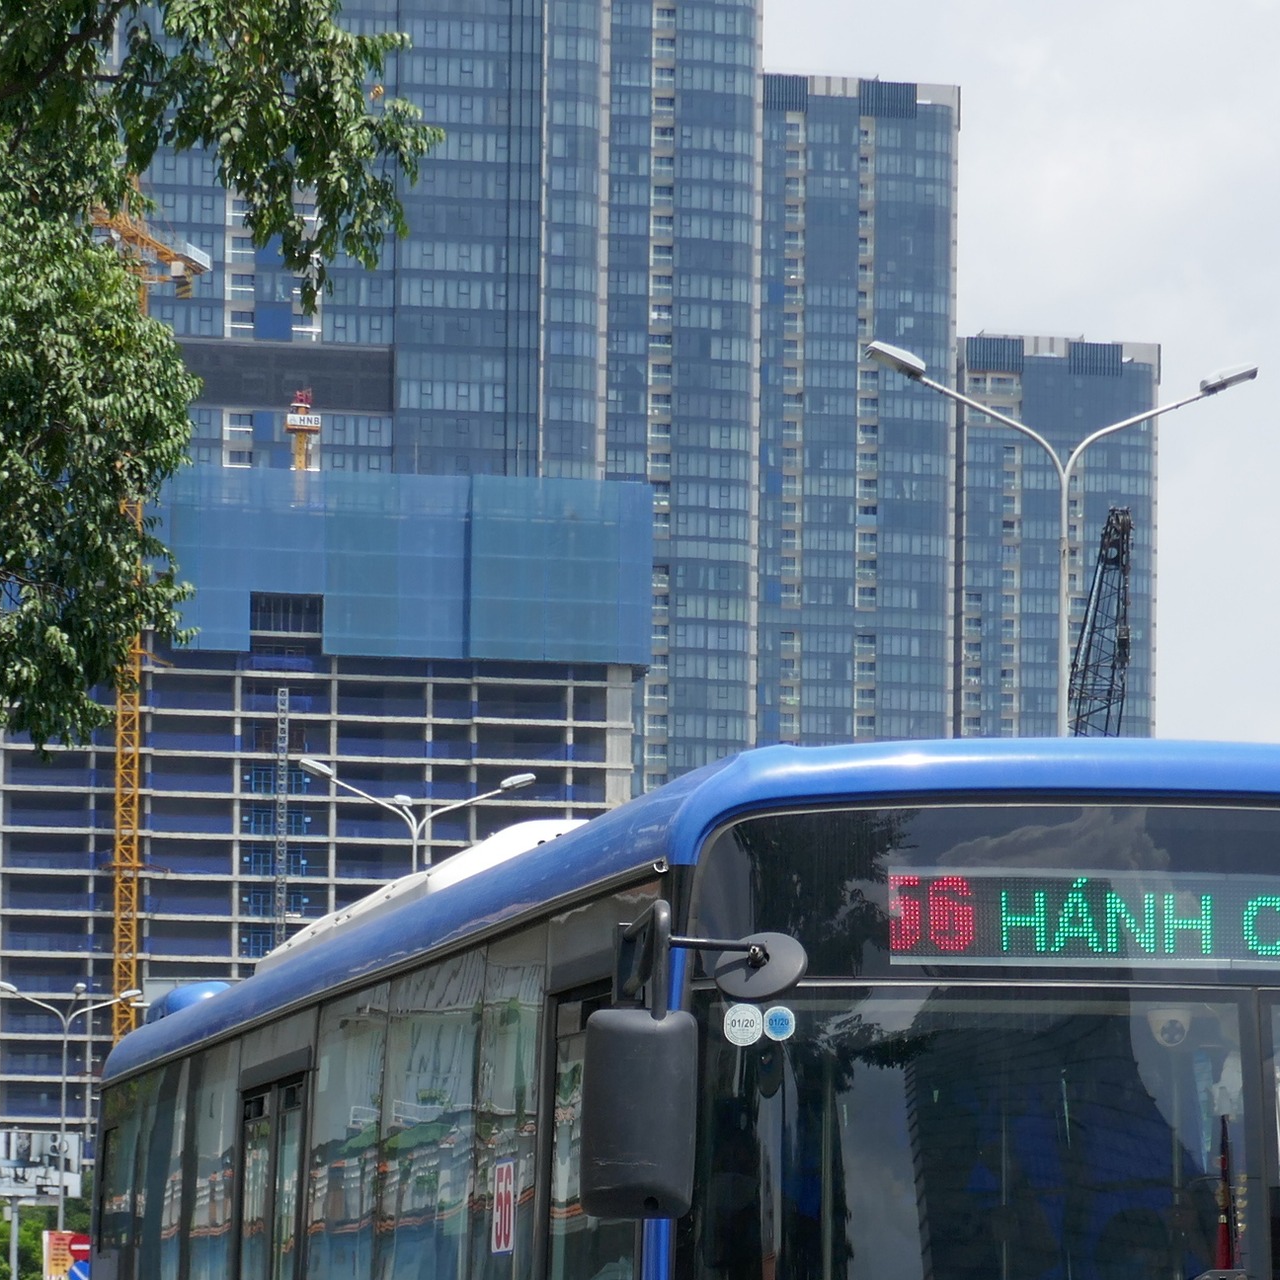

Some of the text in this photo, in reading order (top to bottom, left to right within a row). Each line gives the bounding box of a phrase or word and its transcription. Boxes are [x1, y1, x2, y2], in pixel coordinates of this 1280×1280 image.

[299, 416, 320, 425] HNB
[889, 875, 973, 951] 56
[1001, 877, 1213, 954] HÁNH
[731, 1019, 755, 1028] 01/20
[768, 1018, 789, 1026] 01/20
[495, 1164, 512, 1250] 56
